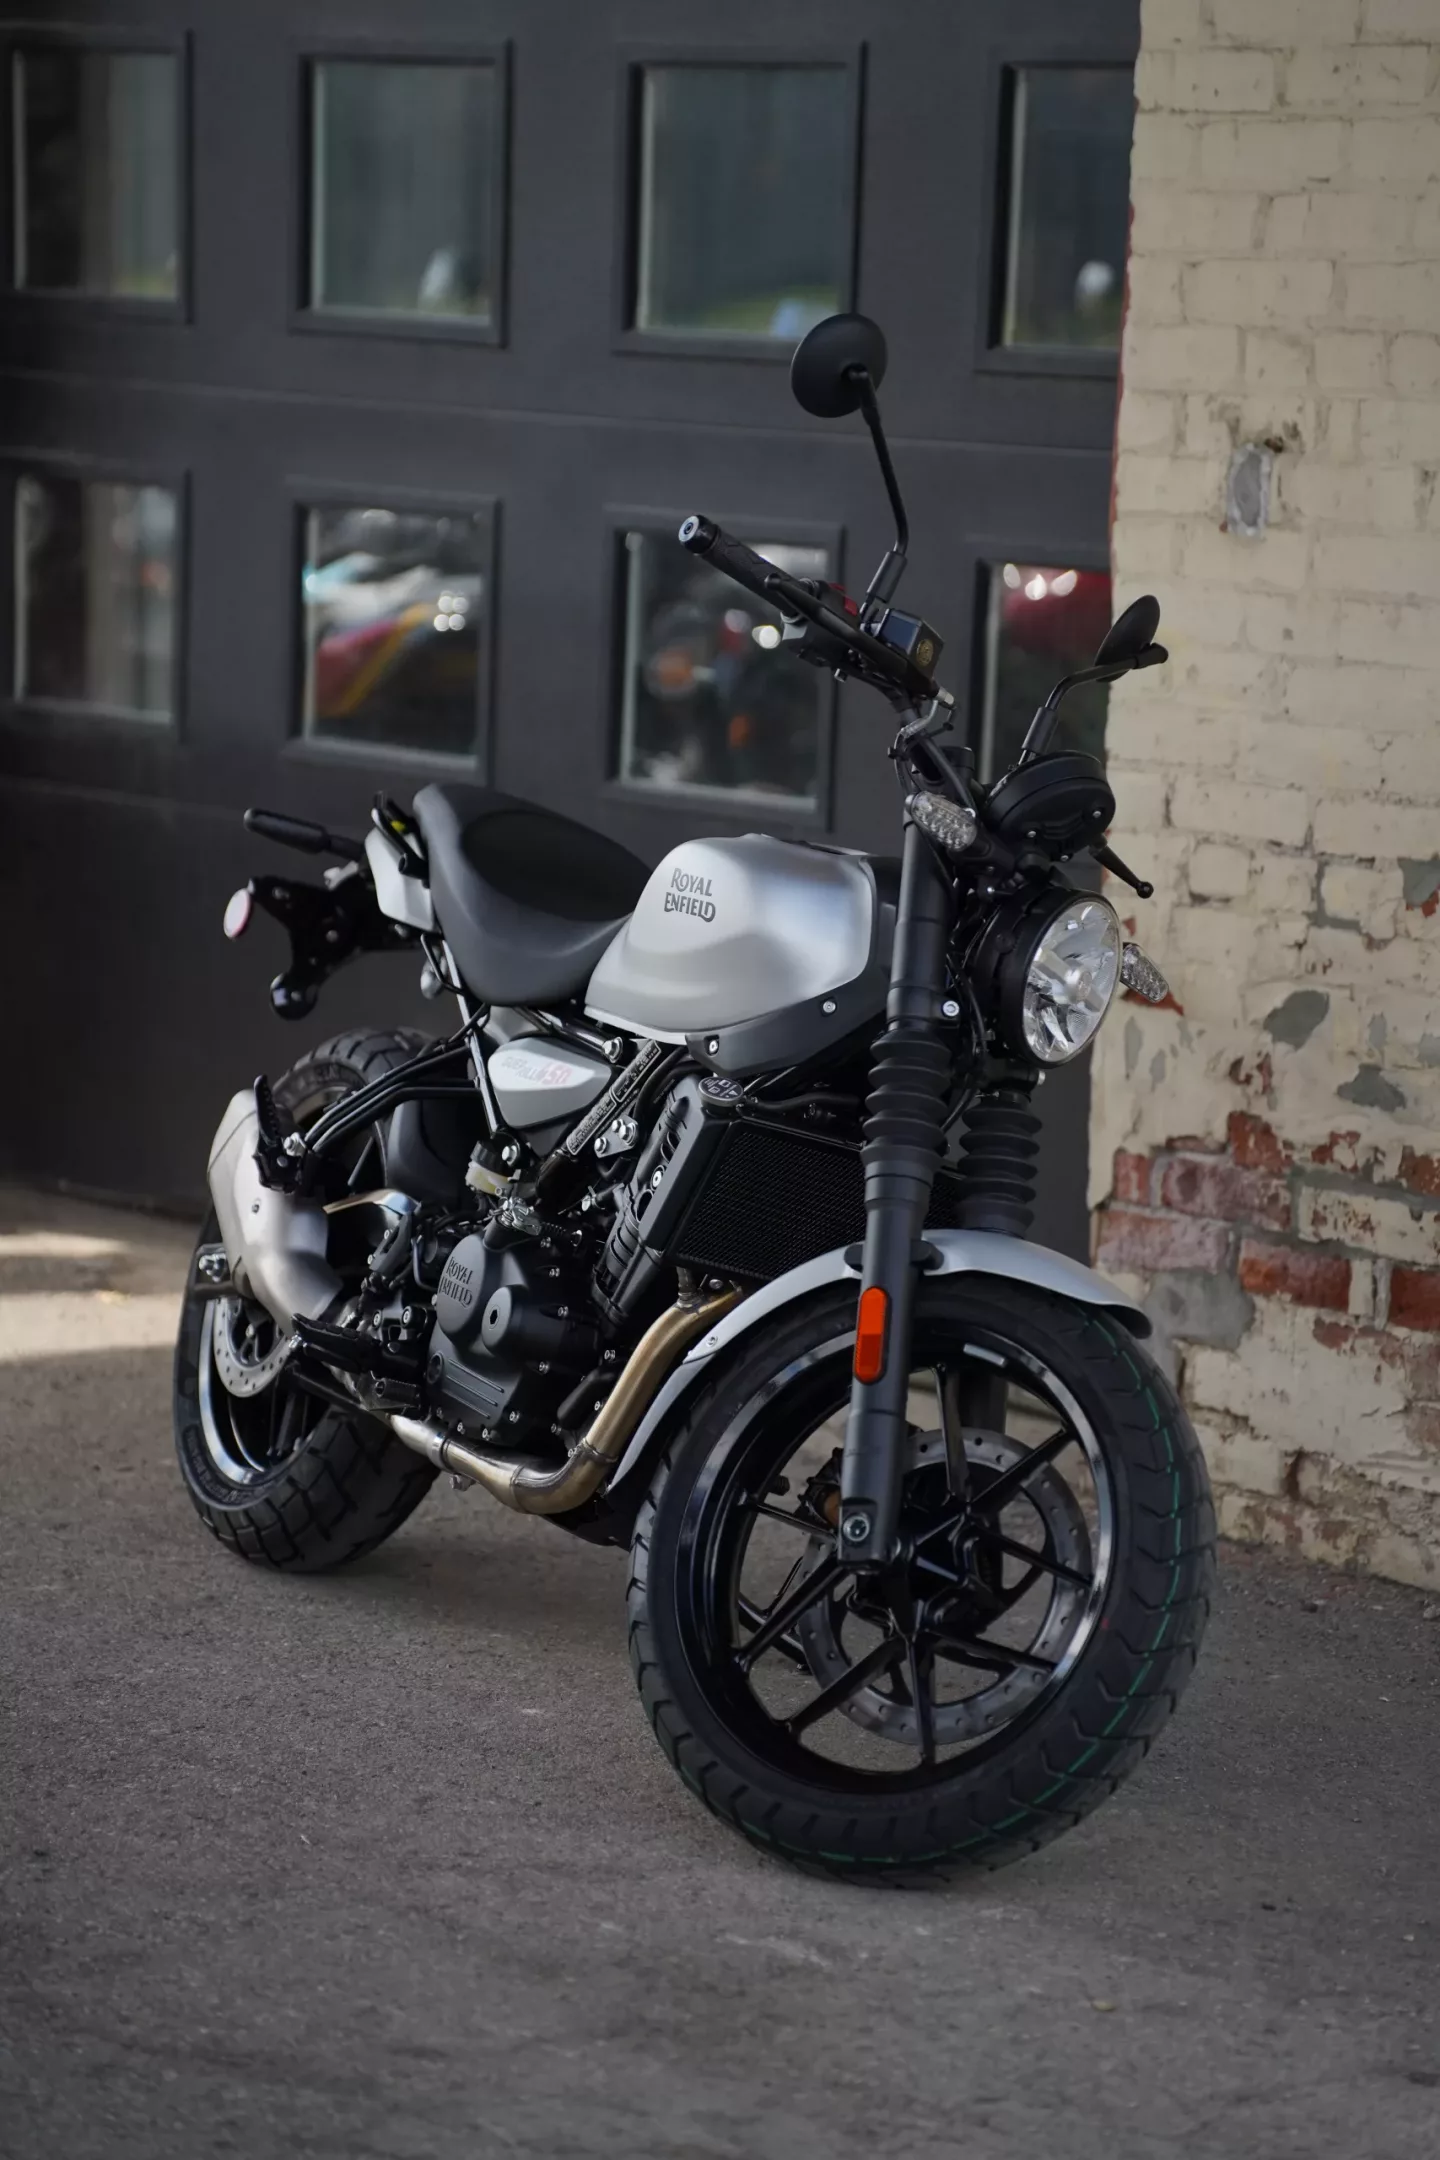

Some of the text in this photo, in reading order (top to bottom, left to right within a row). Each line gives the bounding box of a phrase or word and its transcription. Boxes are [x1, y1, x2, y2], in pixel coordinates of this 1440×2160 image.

[670, 867, 713, 897] ROYAL
[663, 892, 716, 923] ENFIELD
[446, 1256, 474, 1285] ROYAL
